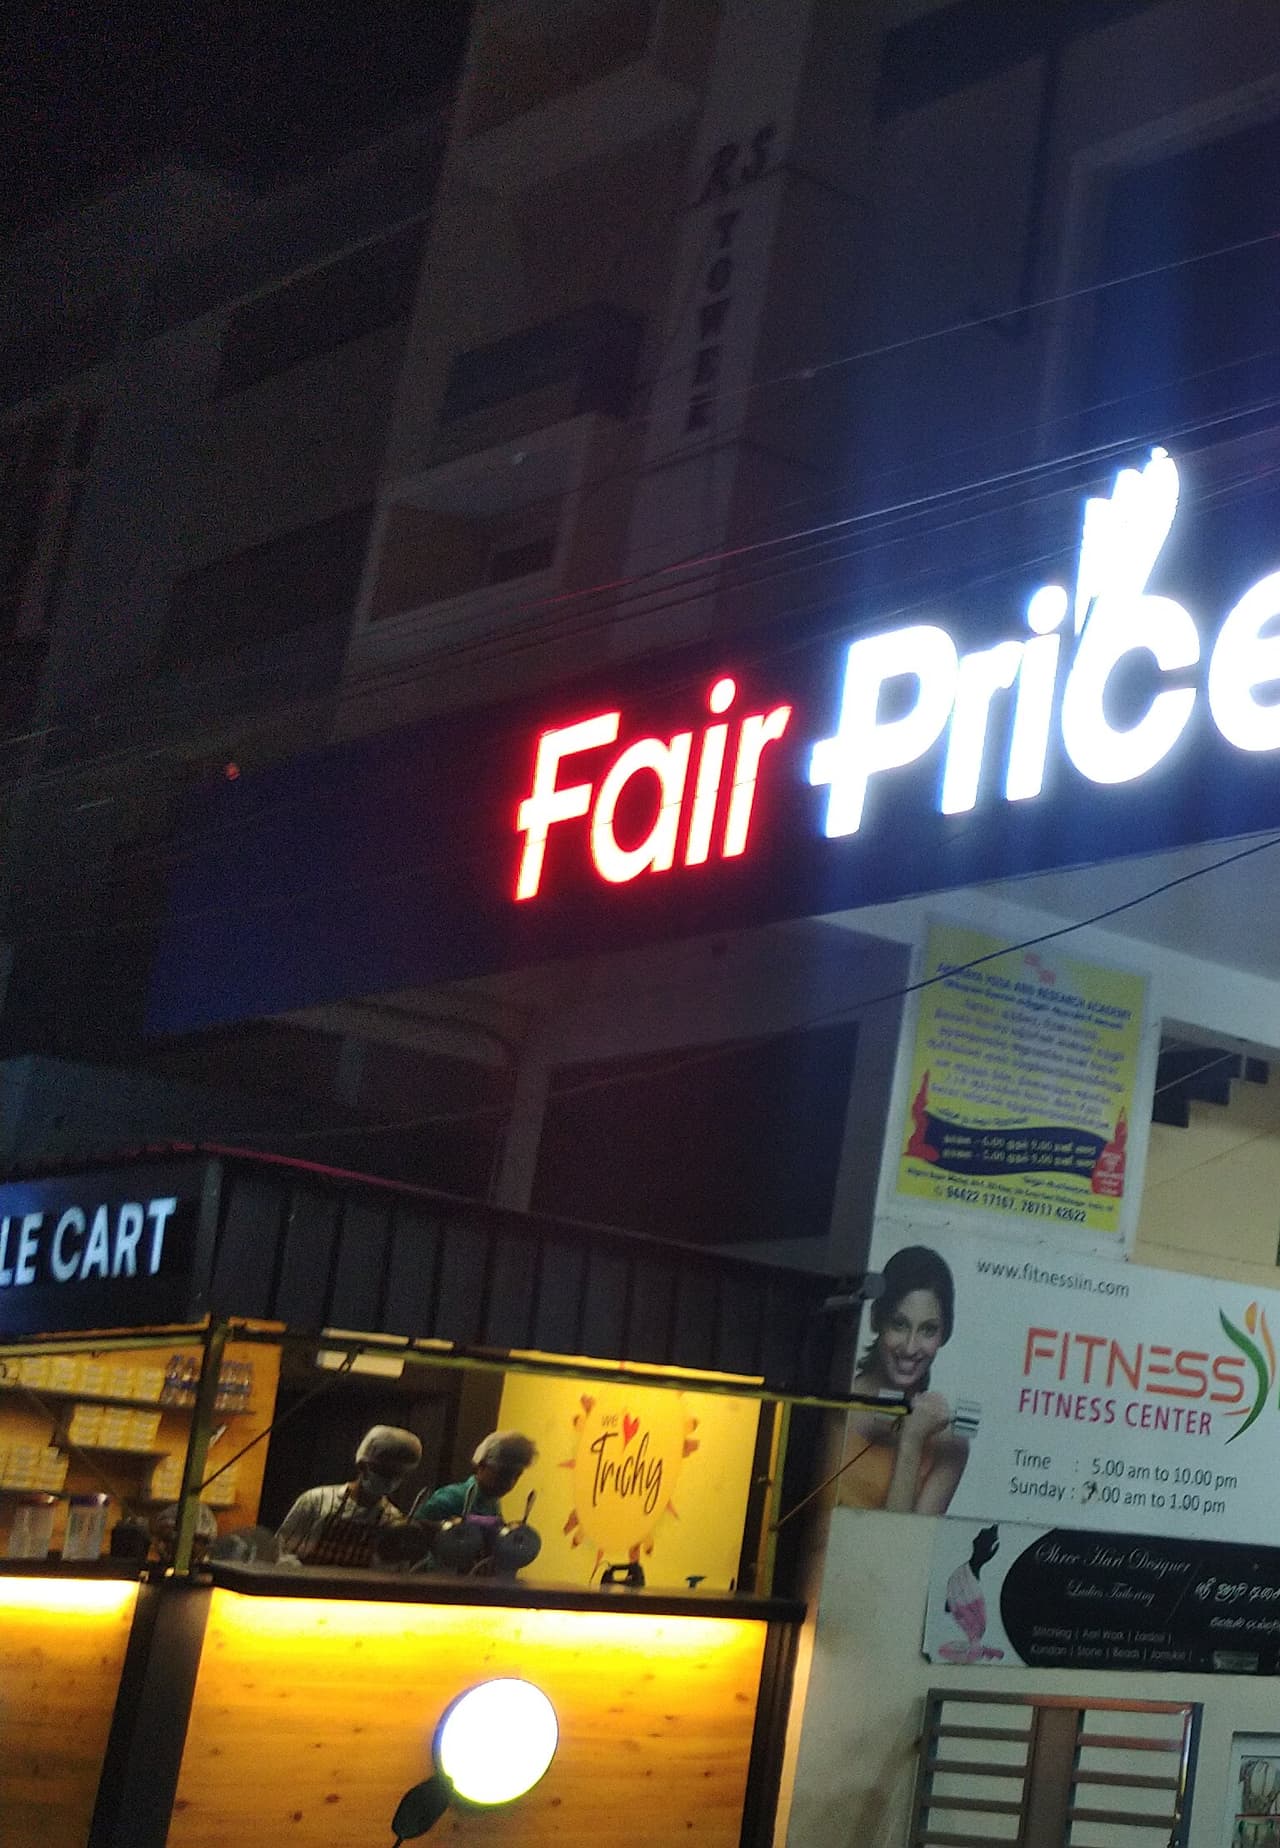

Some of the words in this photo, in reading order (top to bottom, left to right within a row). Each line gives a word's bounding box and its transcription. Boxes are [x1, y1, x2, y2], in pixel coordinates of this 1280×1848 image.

[514, 676, 792, 903] Fair
[51, 1196, 178, 1283] CART
[976, 1258, 1131, 1298] www.fitnessiin.com
[1022, 1326, 1247, 1405] FITNESS
[1018, 1388, 1117, 1425] FITNESS
[1125, 1400, 1213, 1437] CENTER
[591, 1431, 663, 1514] Trichy
[1013, 1448, 1052, 1471] Time
[1092, 1457, 1125, 1478] 5.00
[1128, 1464, 1151, 1481] am
[1154, 1465, 1170, 1482] to
[1173, 1466, 1213, 1487] 10.00
[1214, 1472, 1238, 1491] pm
[1009, 1476, 1067, 1502] Sunday
[1123, 1488, 1147, 1506] am
[1150, 1491, 1166, 1508] to
[1169, 1492, 1201, 1512] 1.00
[1202, 1497, 1226, 1515] pm
[1035, 1542, 1082, 1566] Shree
[1128, 1547, 1192, 1579] Designer
